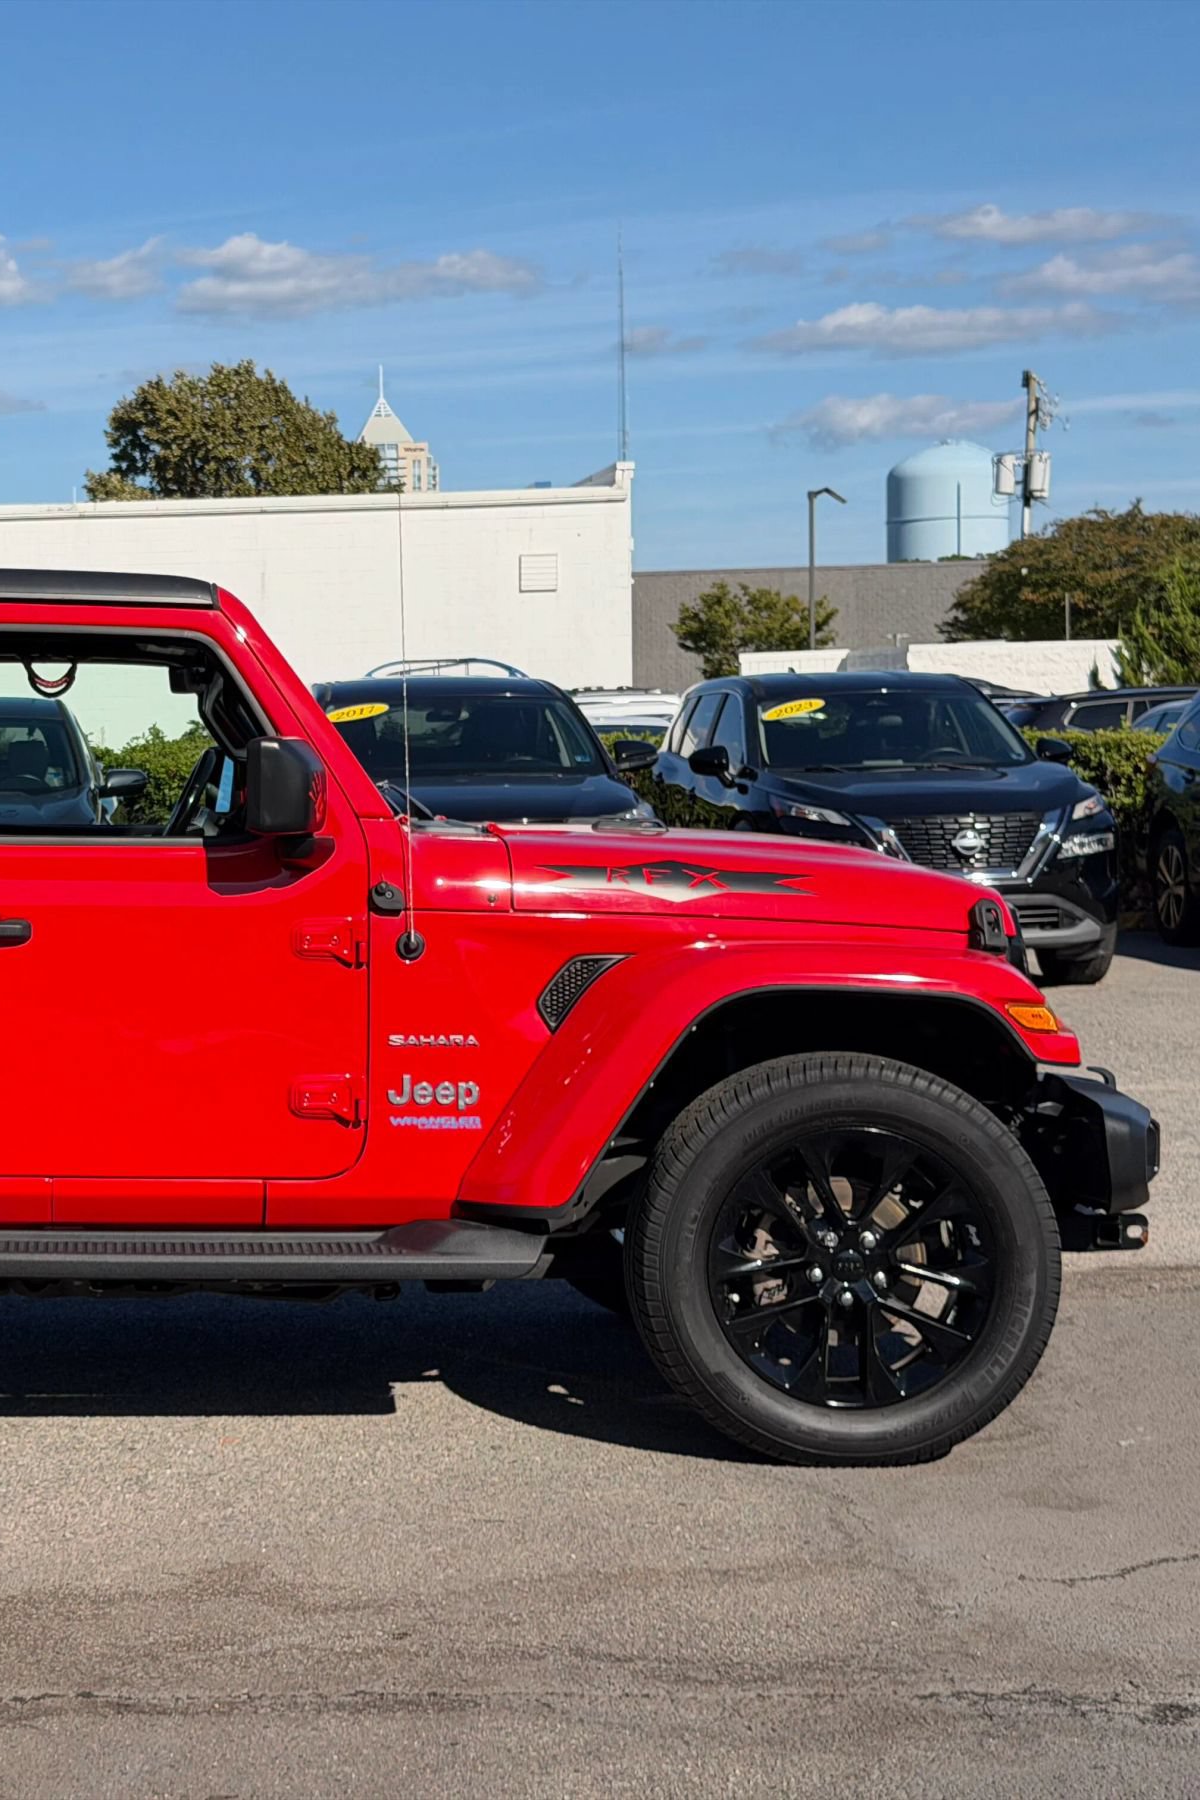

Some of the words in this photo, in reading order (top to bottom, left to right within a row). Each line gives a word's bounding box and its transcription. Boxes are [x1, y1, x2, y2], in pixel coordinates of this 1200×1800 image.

[335, 705, 376, 721] 2017
[774, 701, 814, 718] 2023
[605, 867, 730, 890] REX
[388, 1034, 479, 1047] SAHARA
[387, 1074, 480, 1110] Jeep
[389, 1116, 482, 1130] WRANGLER
